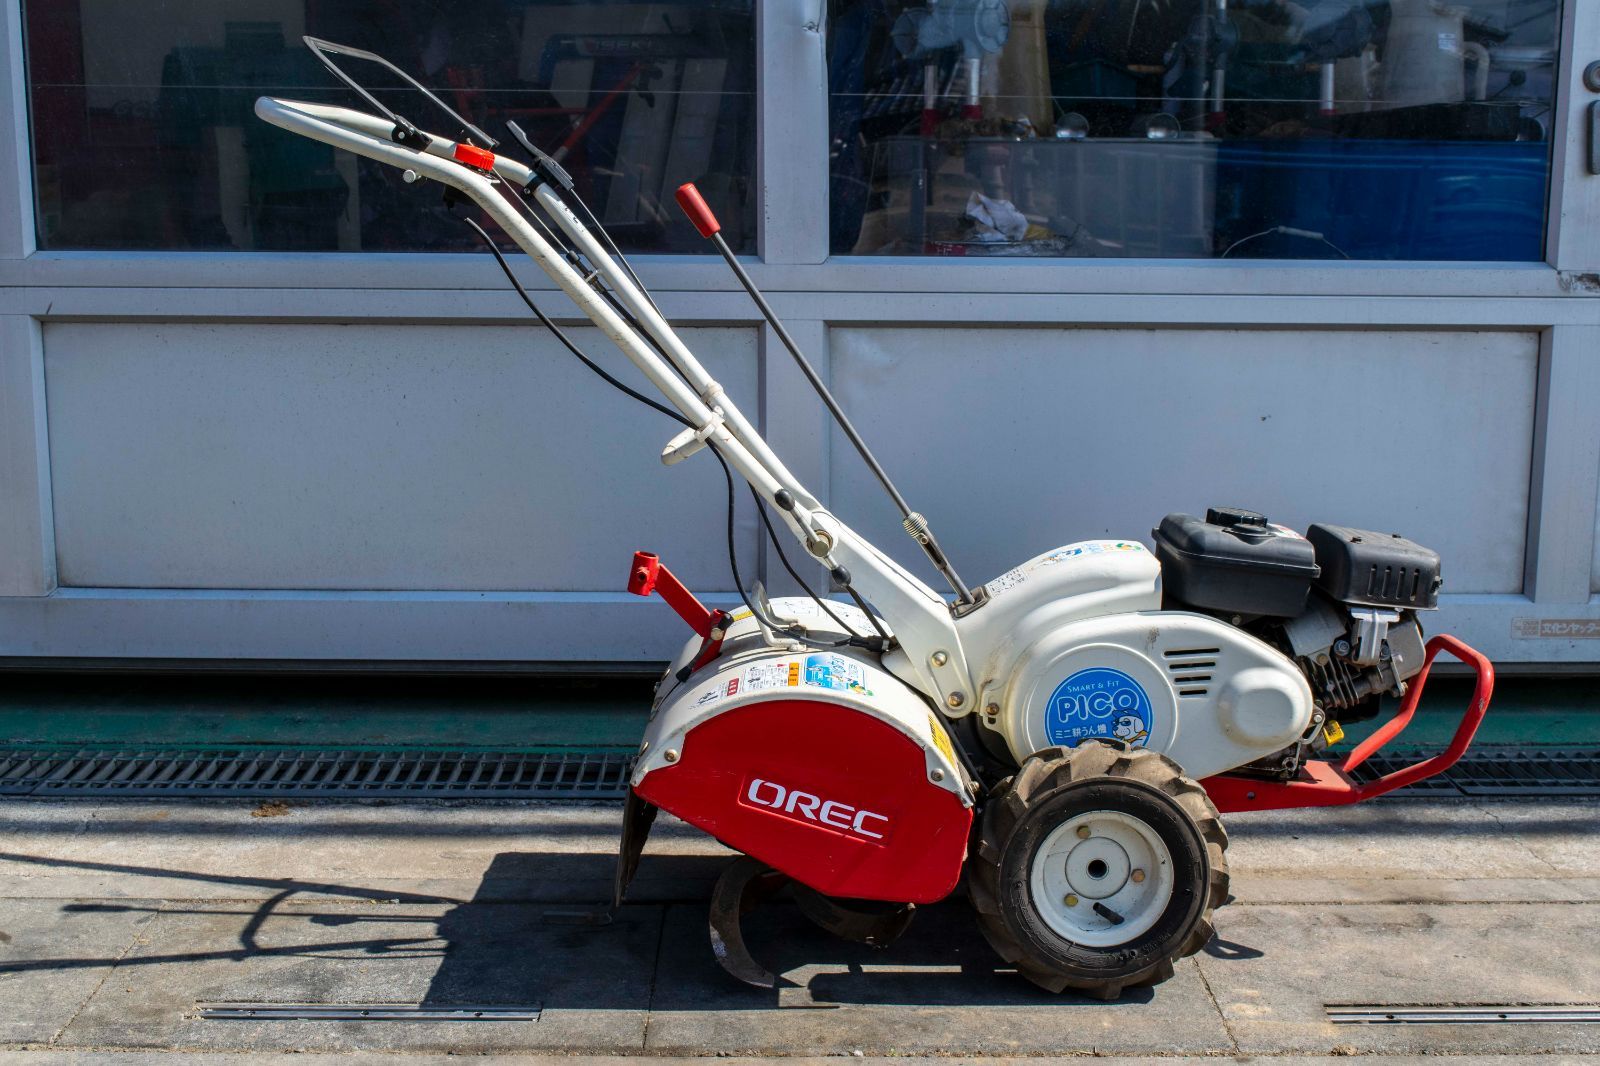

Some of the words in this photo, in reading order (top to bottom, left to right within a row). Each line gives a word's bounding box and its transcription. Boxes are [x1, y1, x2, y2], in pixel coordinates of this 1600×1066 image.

[1067, 684, 1095, 693] SMART
[1057, 688, 1139, 722] PICO
[1056, 724, 1107, 738] ミニ耕うん機
[747, 778, 889, 839] OREC
